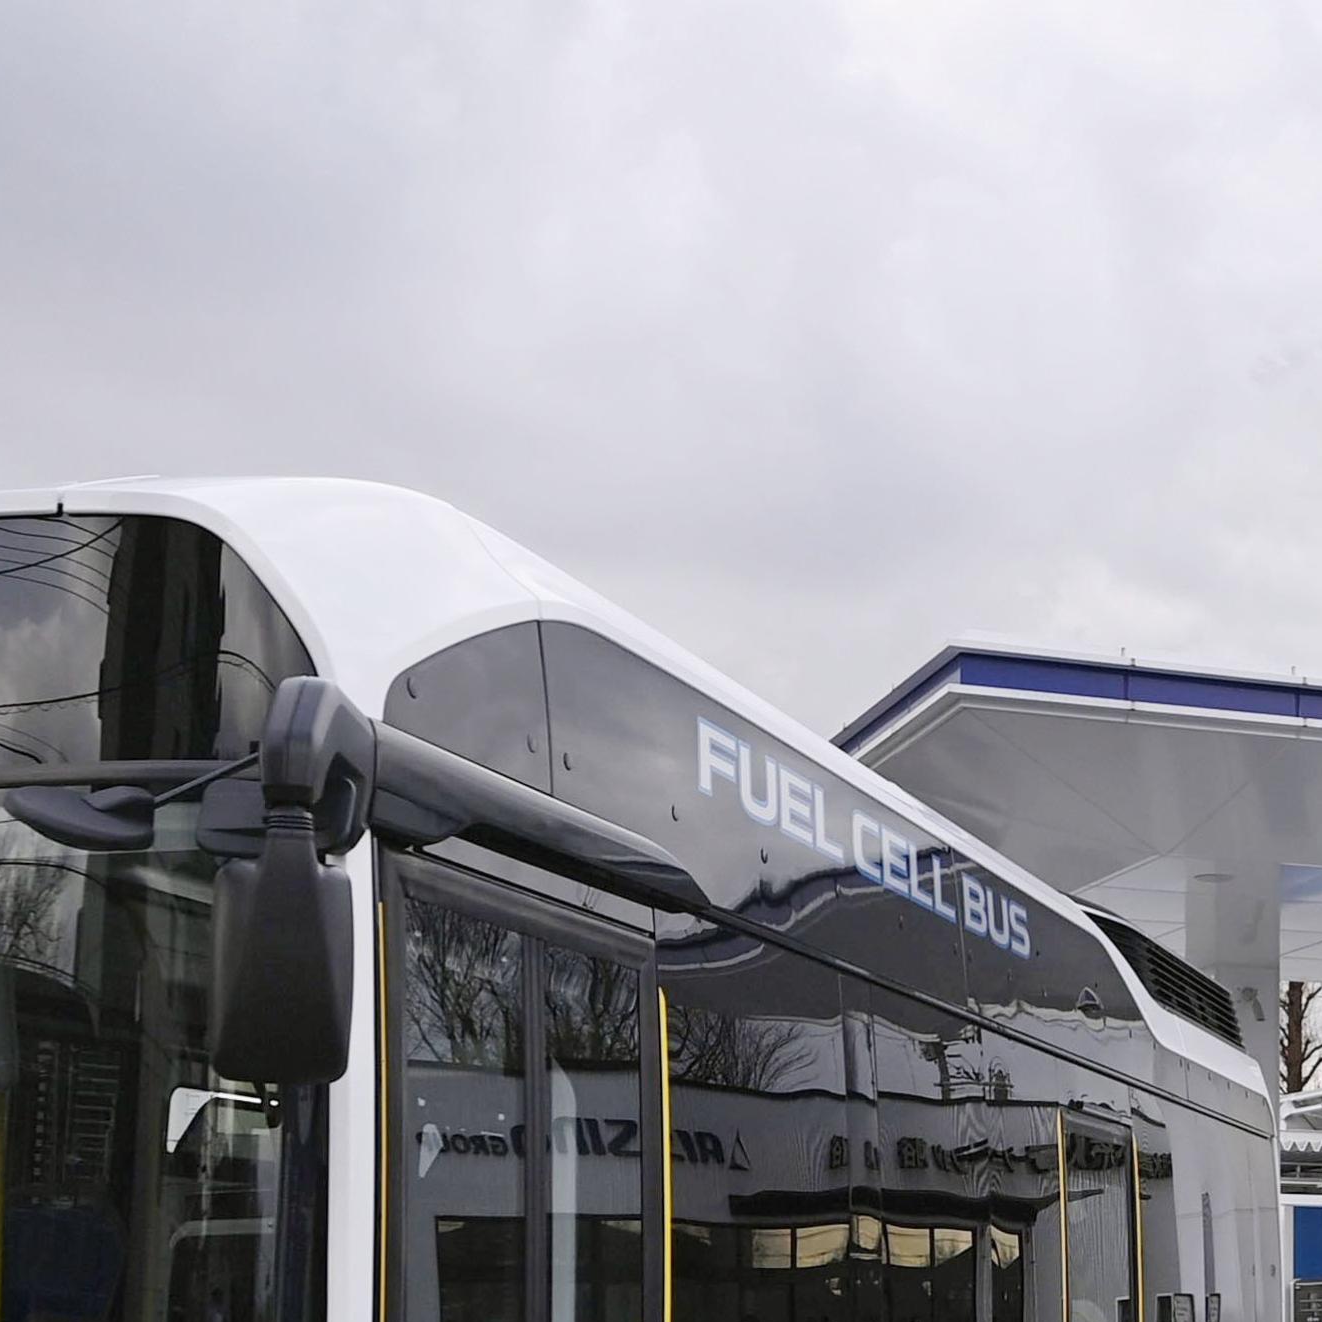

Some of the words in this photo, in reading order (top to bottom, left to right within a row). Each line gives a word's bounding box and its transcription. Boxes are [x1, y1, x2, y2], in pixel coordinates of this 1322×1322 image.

[697, 716, 845, 866] FUEL
[852, 808, 957, 924] CELL
[961, 870, 1031, 960] BUS
